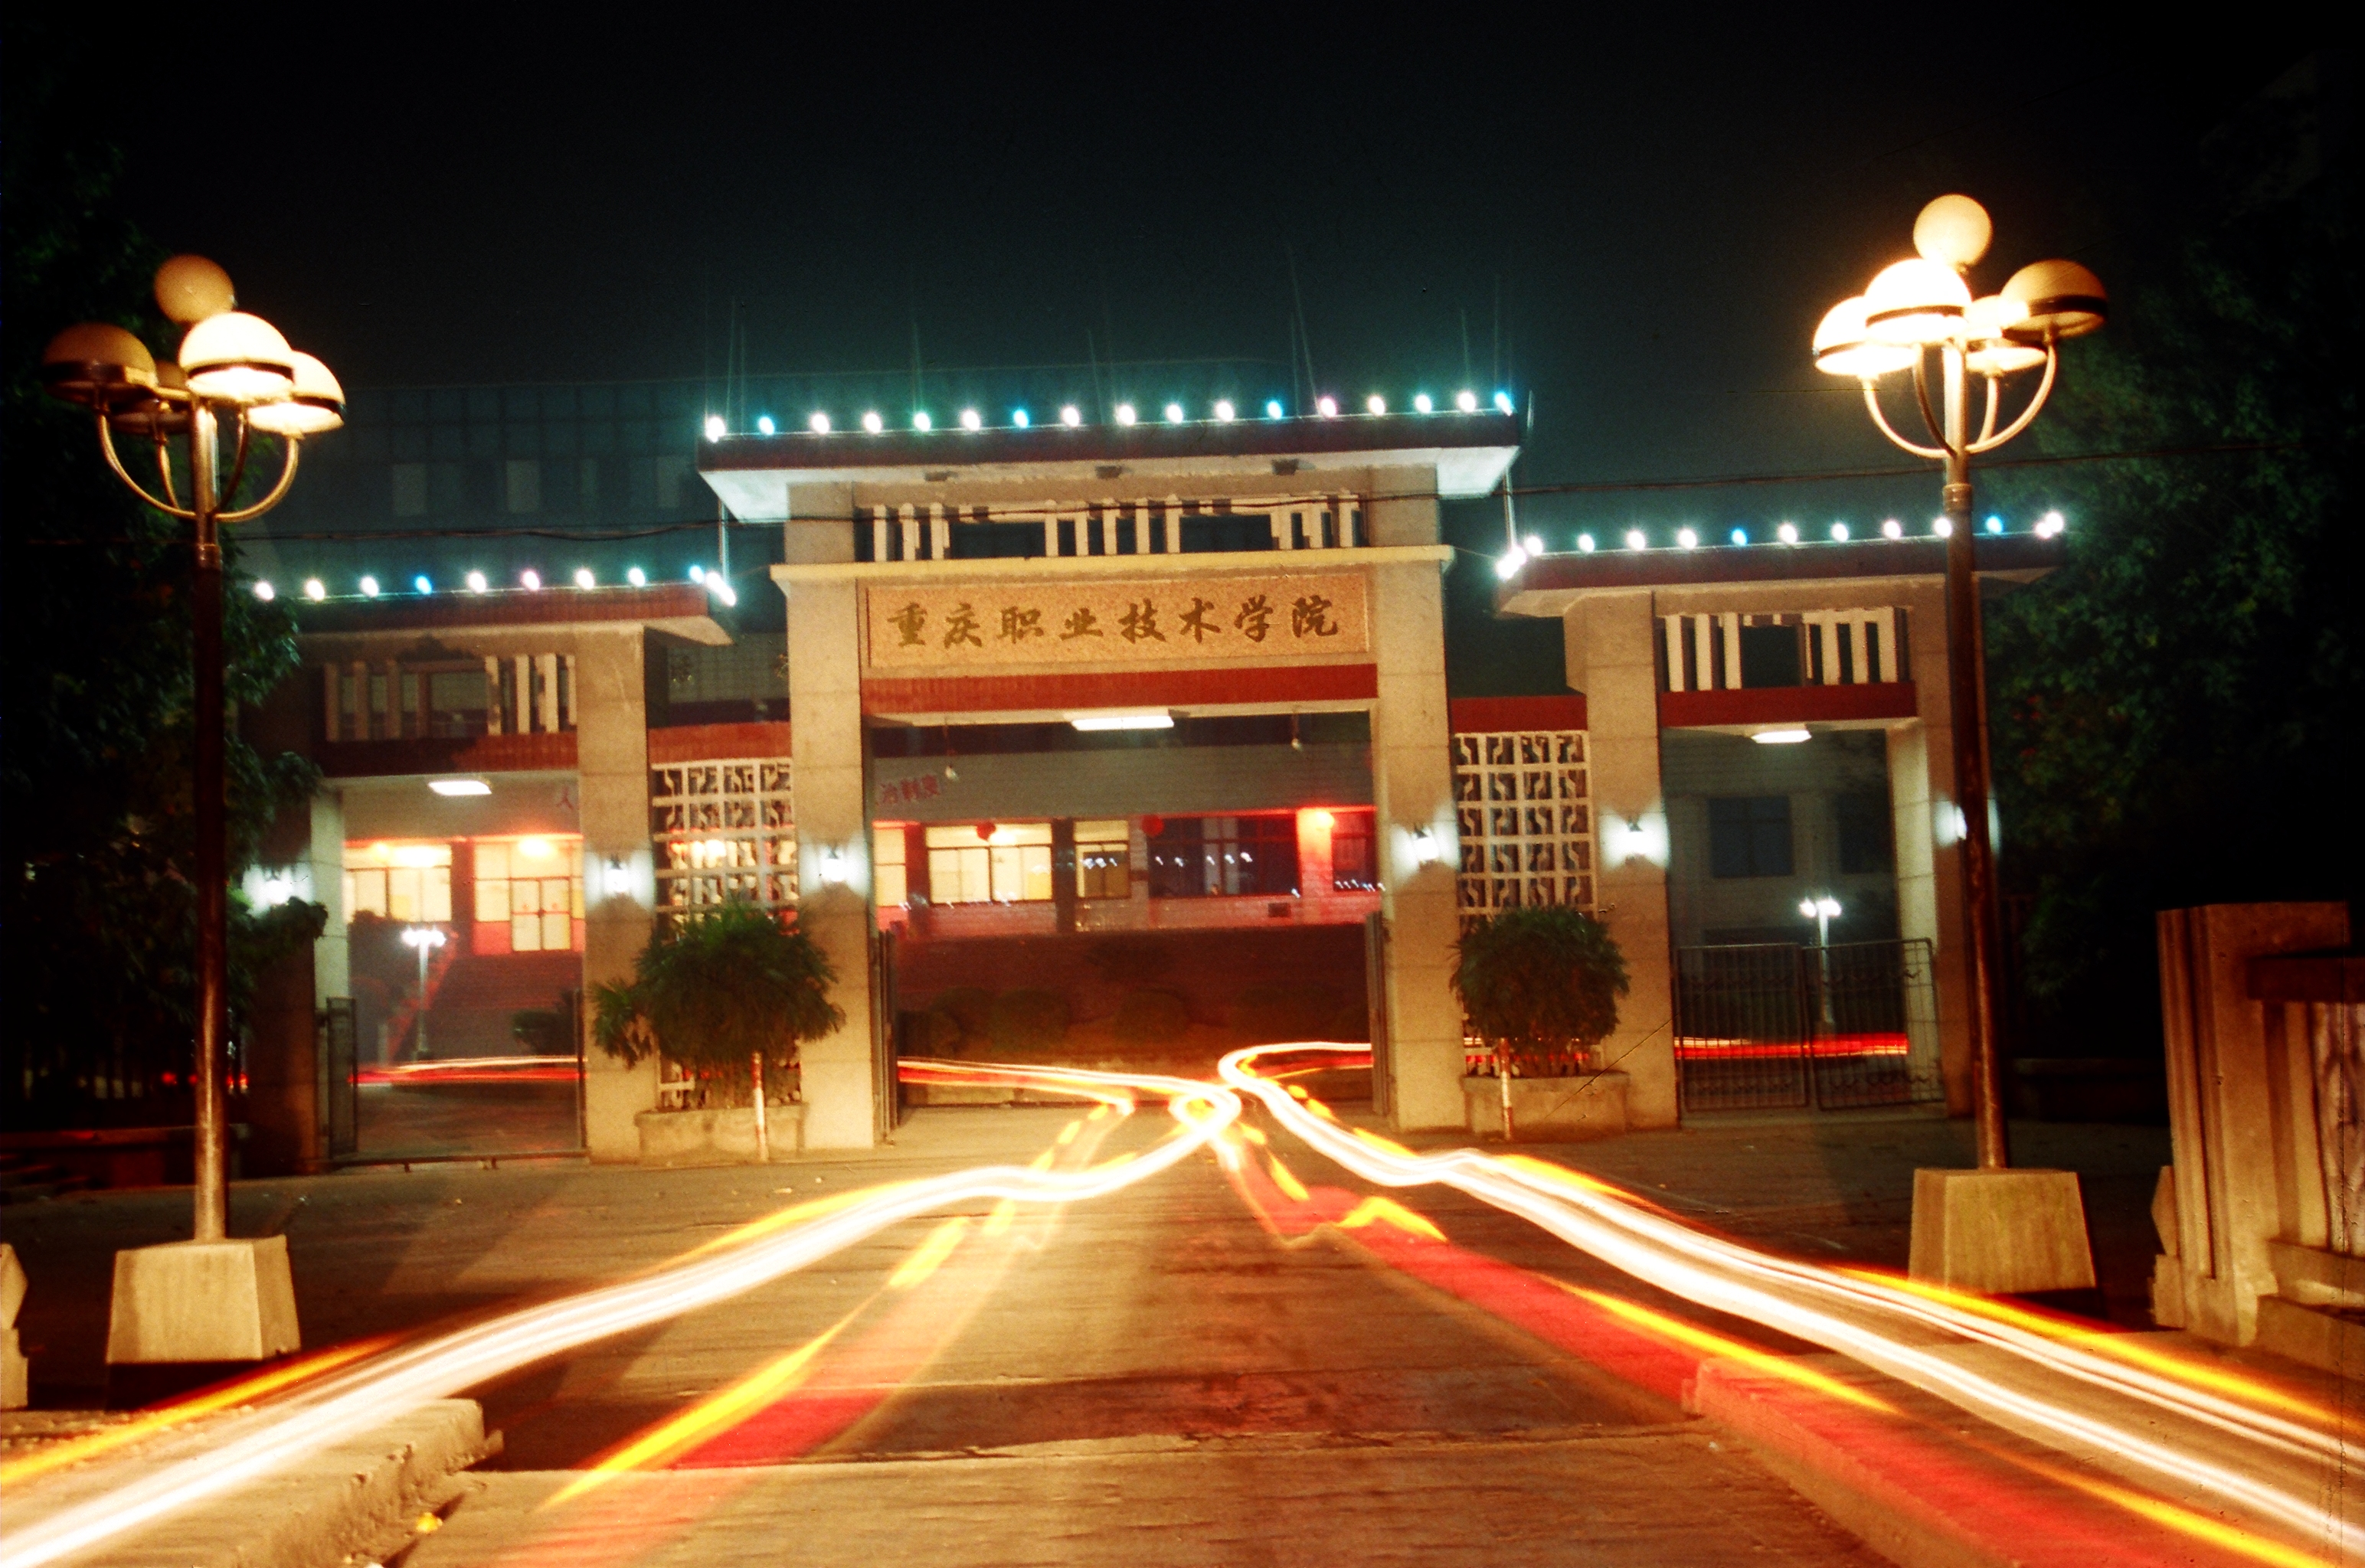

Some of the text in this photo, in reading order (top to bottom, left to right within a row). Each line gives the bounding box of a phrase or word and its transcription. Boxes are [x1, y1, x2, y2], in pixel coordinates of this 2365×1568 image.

[887, 594, 1339, 649] 重庆职业技术学院
